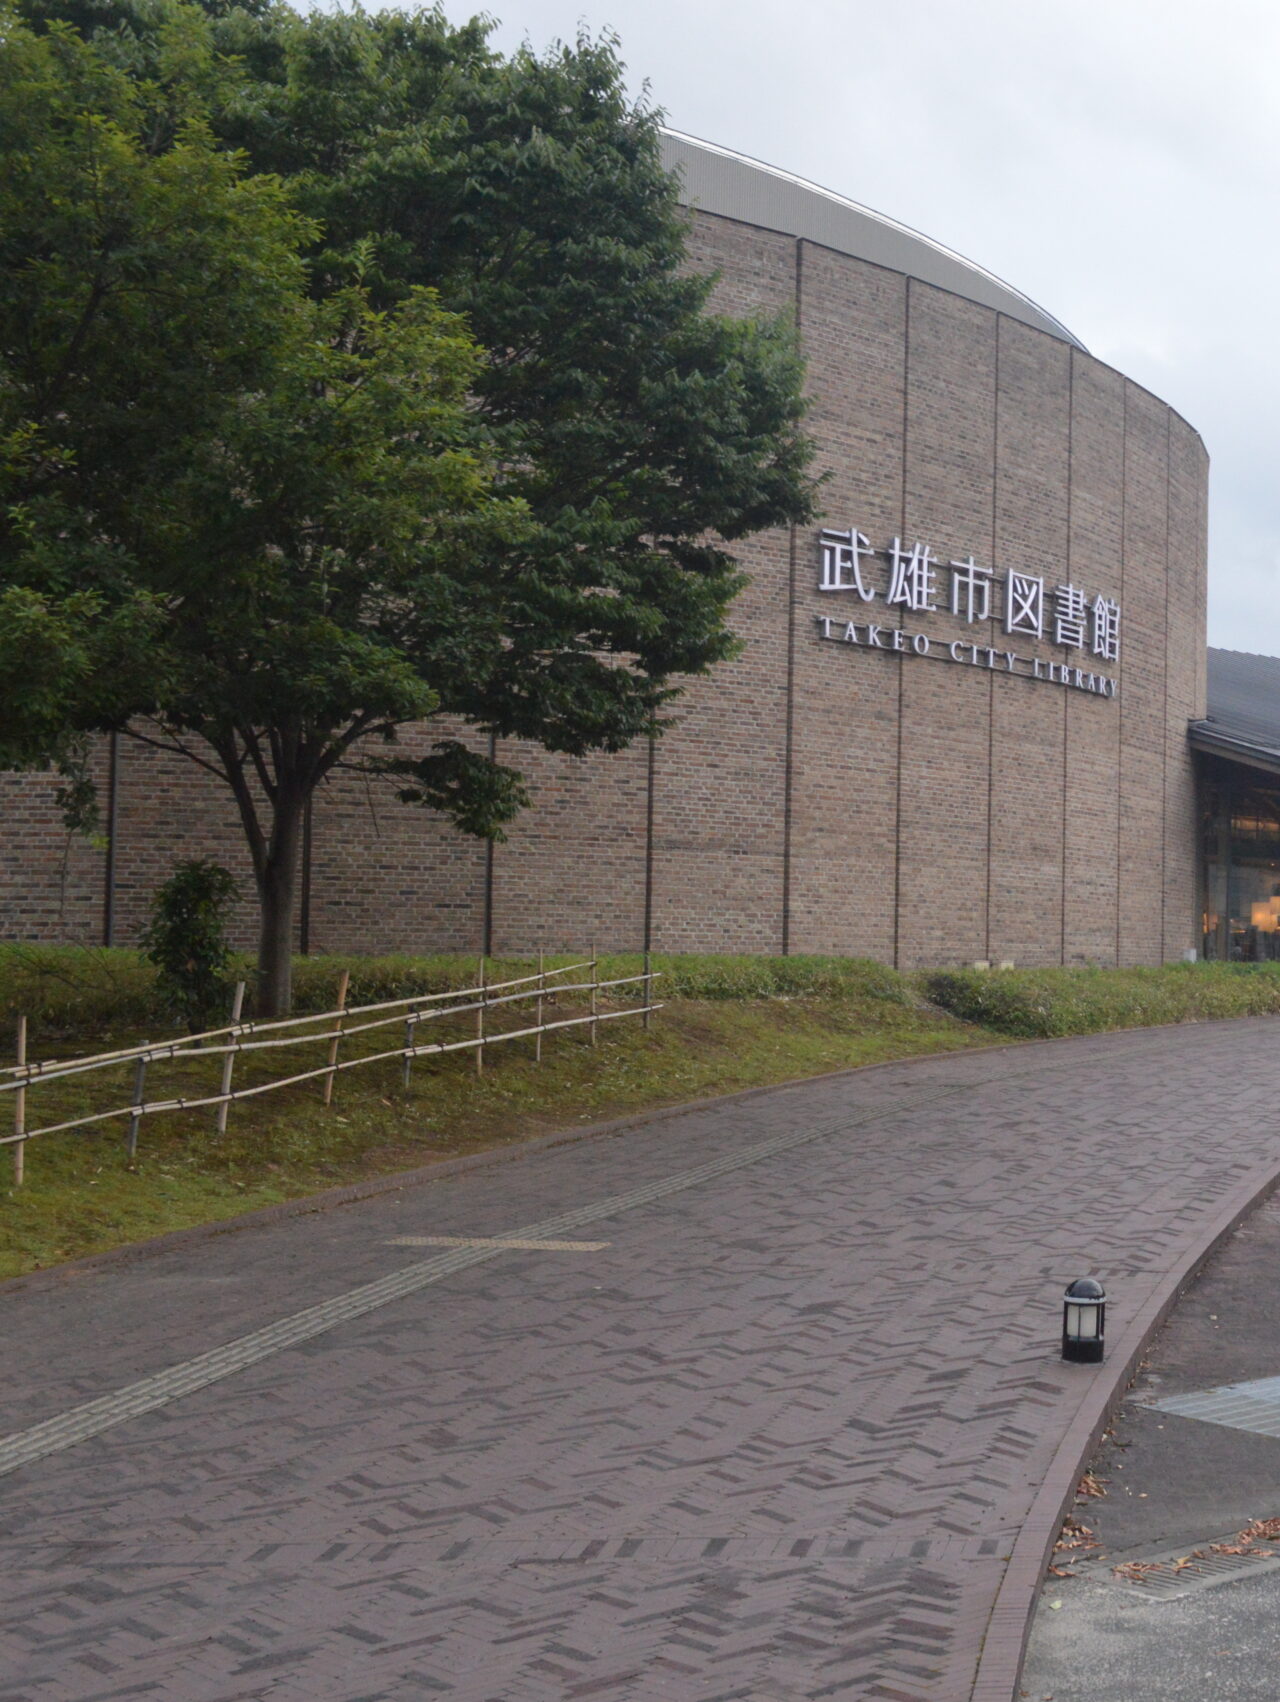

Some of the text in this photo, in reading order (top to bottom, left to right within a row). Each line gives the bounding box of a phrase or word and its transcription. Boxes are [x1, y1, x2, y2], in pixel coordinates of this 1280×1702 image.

[819, 528, 1120, 662] 武雄市図書館
[819, 616, 1118, 697] TAKEO CITY LIBRARY
